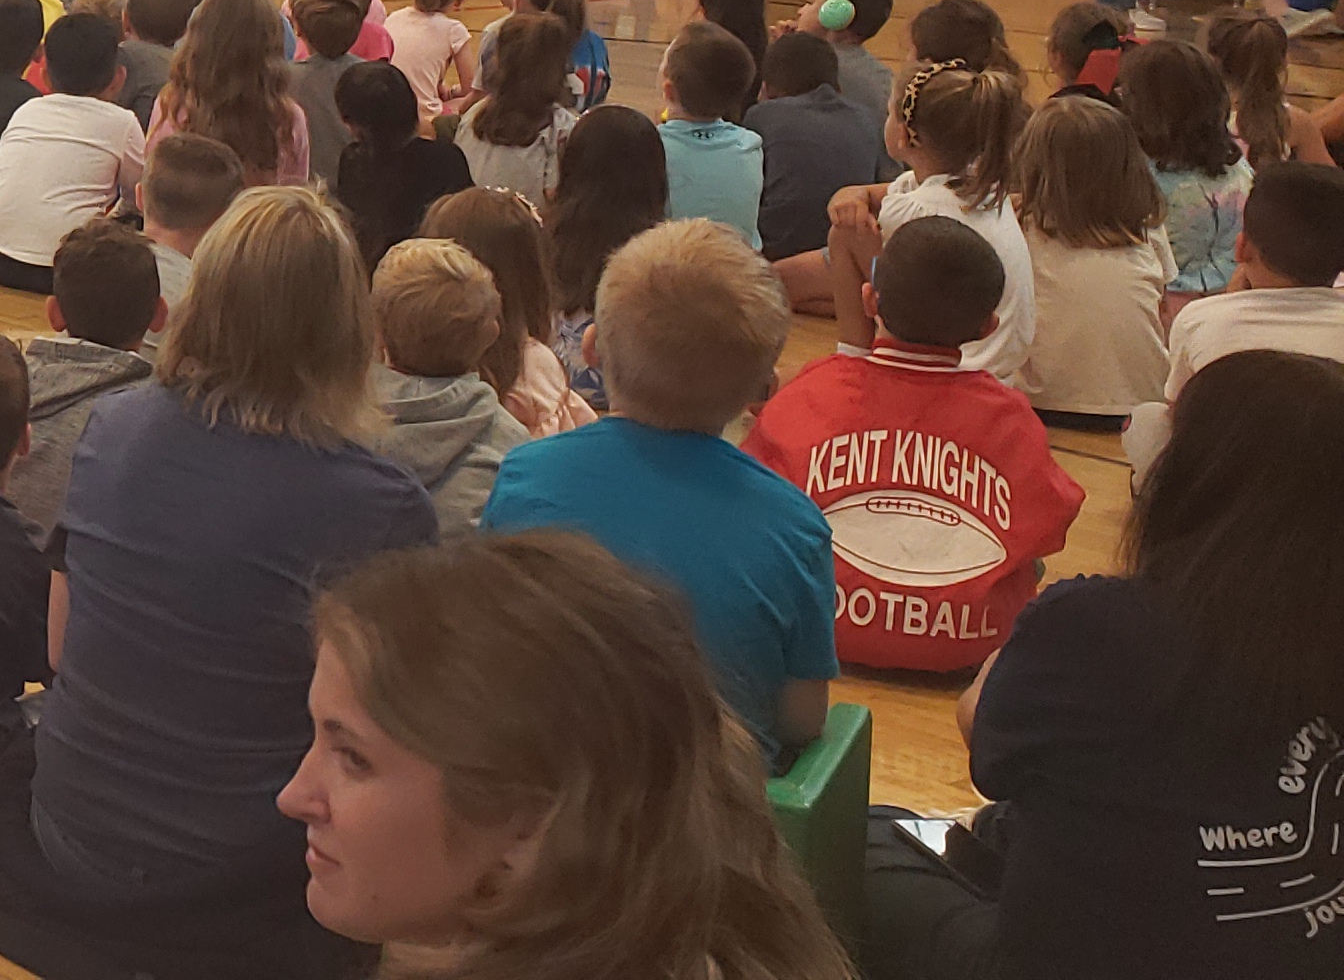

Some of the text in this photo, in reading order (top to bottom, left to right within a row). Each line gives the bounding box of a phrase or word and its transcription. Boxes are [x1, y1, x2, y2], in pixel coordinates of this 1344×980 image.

[806, 429, 1011, 531] KENT KNIGHTS
[1199, 821, 1298, 852] Where
